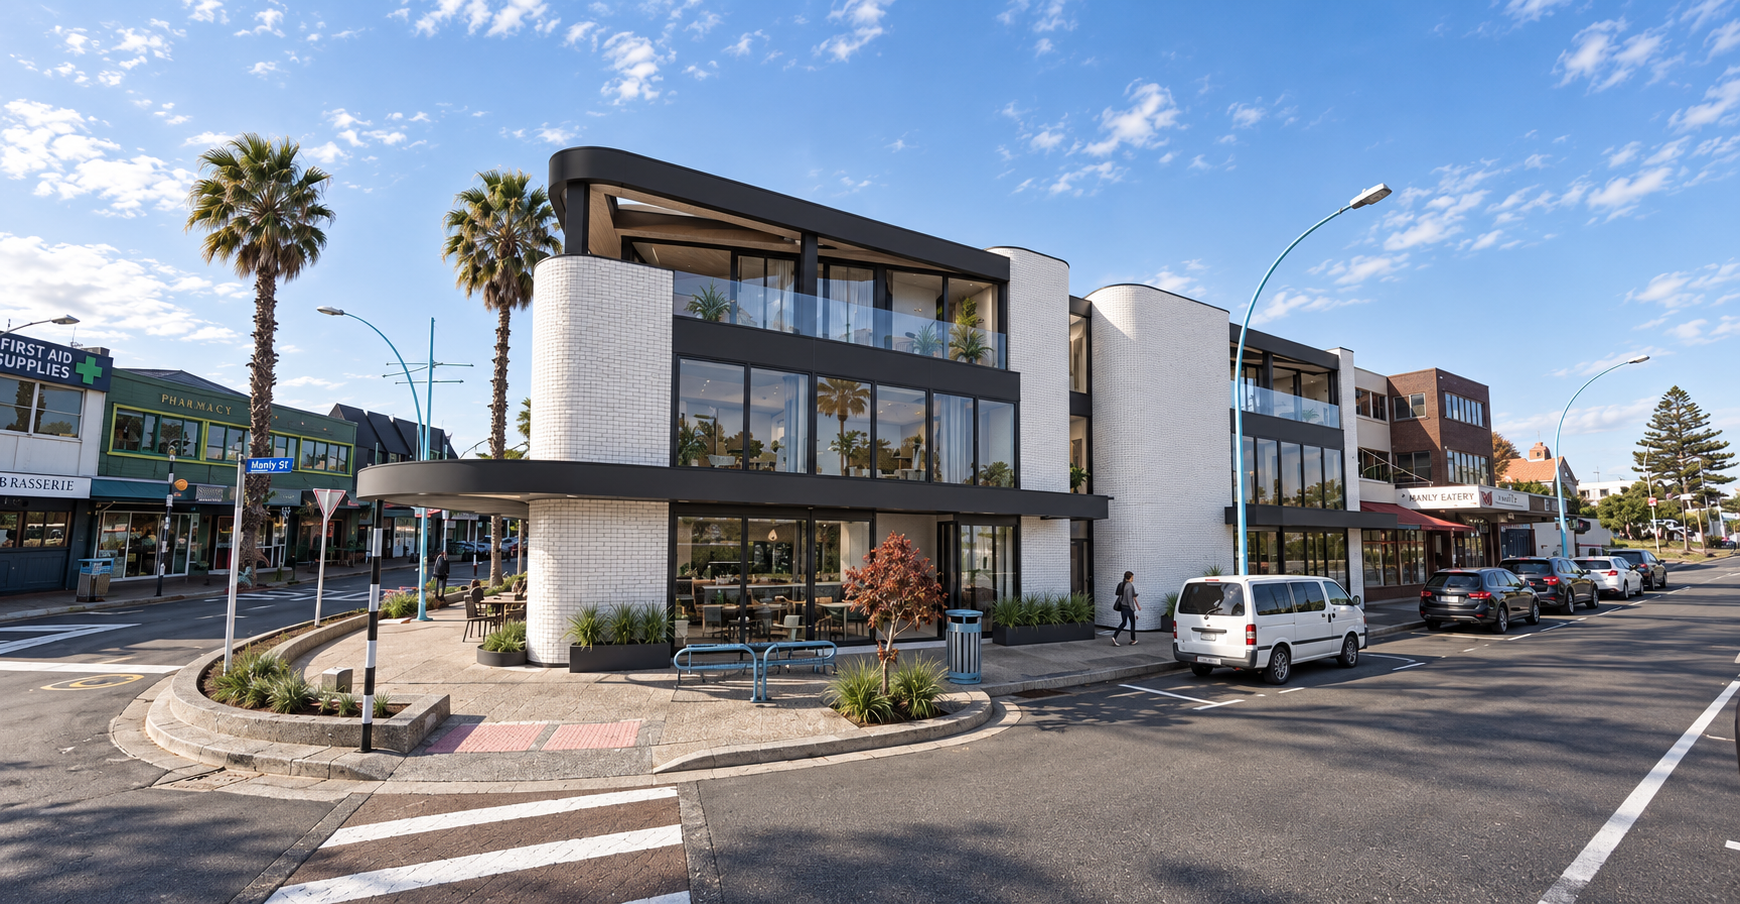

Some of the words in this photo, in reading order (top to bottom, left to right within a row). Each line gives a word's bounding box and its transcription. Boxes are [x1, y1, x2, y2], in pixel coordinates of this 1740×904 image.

[1, 338, 45, 358] FIRST
[47, 349, 72, 364] AID
[161, 393, 232, 416] PHARMACY
[251, 460, 277, 471] Manly
[278, 460, 289, 470] St
[1409, 493, 1438, 502] MANLY
[1440, 492, 1475, 501] EATERY
